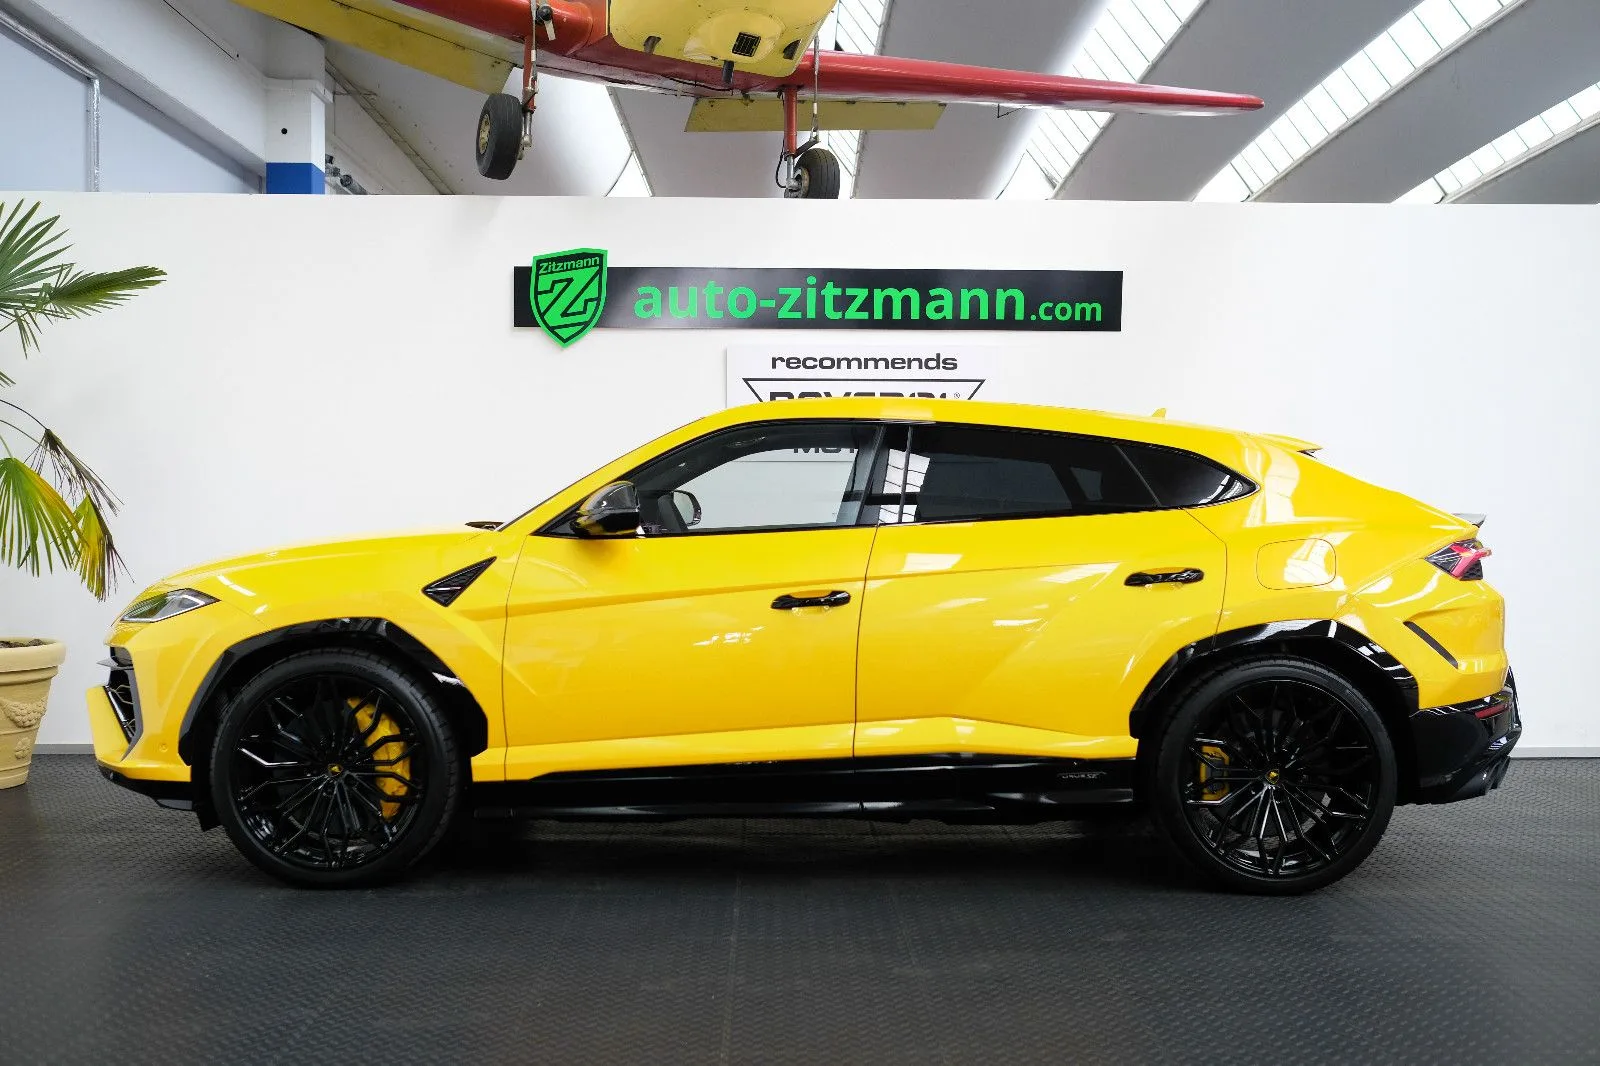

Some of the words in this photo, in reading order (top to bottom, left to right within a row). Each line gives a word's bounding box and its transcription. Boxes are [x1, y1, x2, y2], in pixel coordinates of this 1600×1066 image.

[539, 256, 600, 274] Zitzmann
[633, 275, 1103, 322] auto-zitzmann.com
[771, 353, 959, 371] recommends
